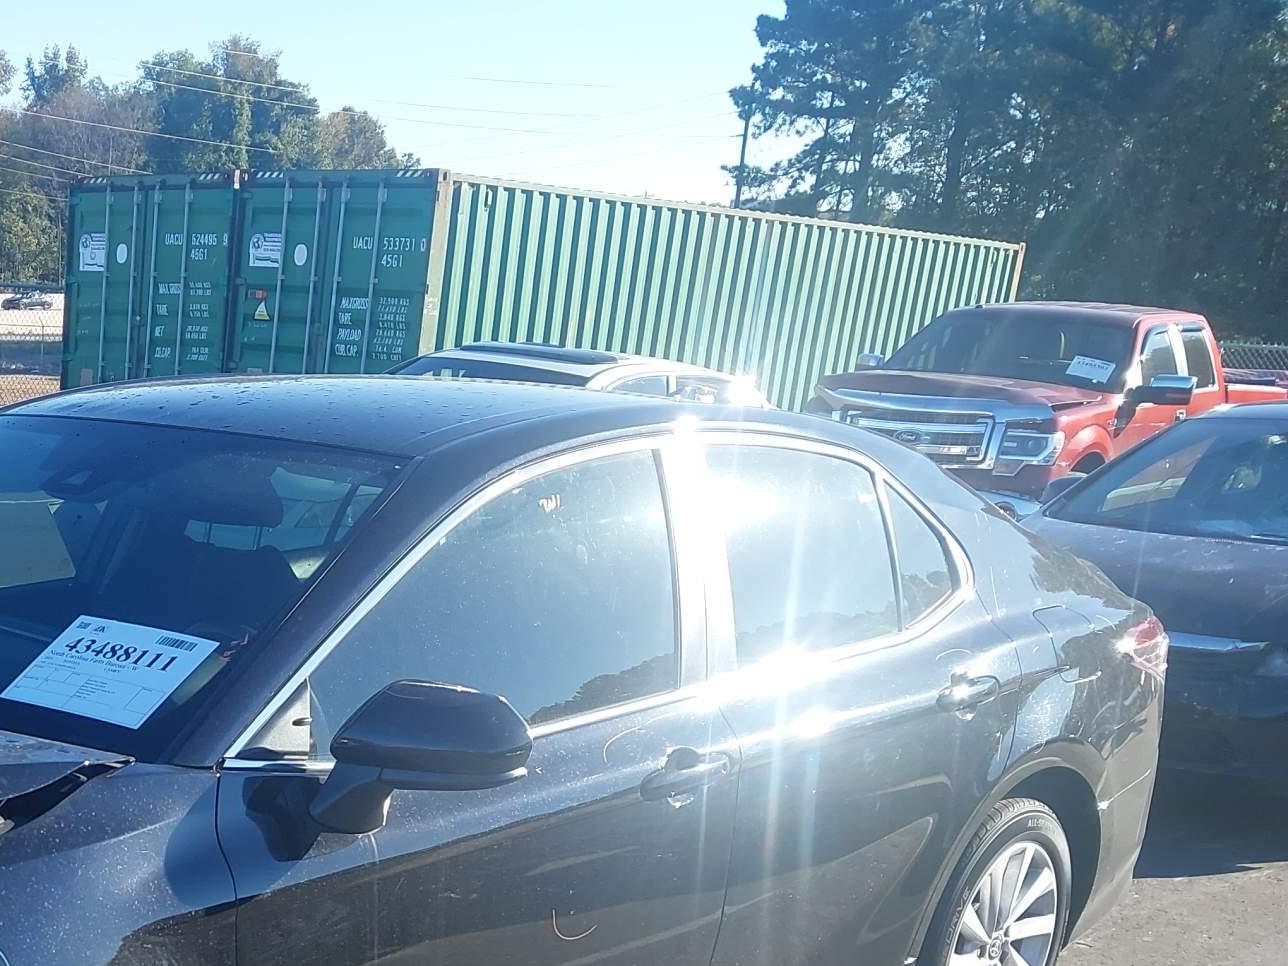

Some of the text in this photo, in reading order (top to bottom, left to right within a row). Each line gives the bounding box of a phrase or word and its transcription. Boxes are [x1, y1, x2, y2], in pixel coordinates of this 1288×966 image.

[353, 236, 373, 249] UACU
[383, 237, 415, 251] 533731
[190, 248, 208, 260] 45G1
[381, 254, 403, 268] 45G1
[64, 636, 180, 673] 43488111
